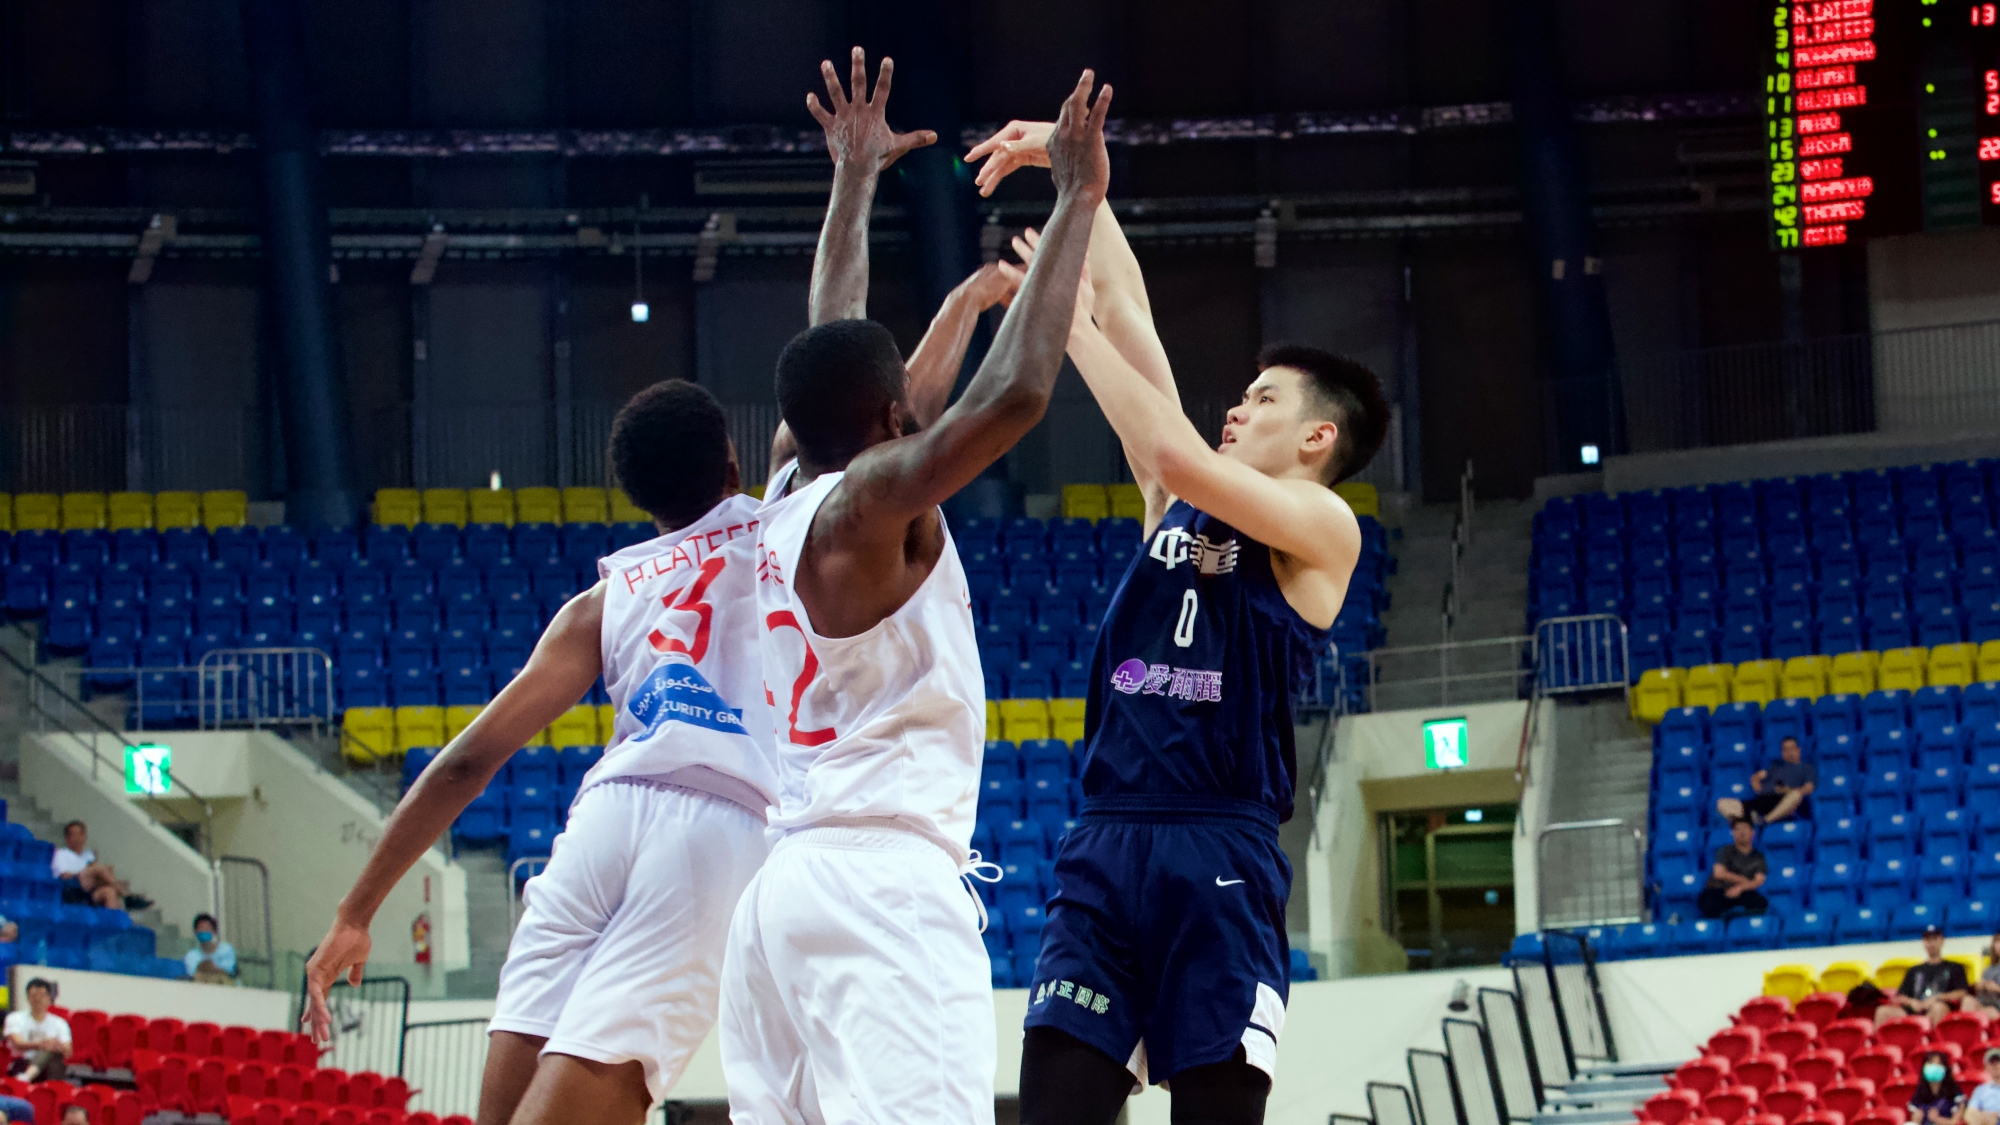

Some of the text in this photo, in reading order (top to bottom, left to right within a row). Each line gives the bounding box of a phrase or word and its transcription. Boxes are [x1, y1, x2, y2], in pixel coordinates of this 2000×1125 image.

[1774, 7, 1788, 27] 2
[1970, 3, 1997, 26] 13
[1775, 28, 1789, 49] 3
[1776, 51, 1790, 69] 4
[1767, 72, 1791, 93] 10
[1984, 69, 2000, 92] 5
[1767, 95, 1791, 115] 11
[1985, 92, 2000, 116] 2
[1769, 117, 1793, 139] 13
[1770, 139, 1794, 160] 15
[1771, 161, 1795, 183] 23
[1772, 184, 1797, 206] 24
[1775, 227, 1799, 248] 77
[624, 519, 760, 595] H.LATE
[647, 555, 727, 666] 3
[1174, 588, 1198, 648] 0
[763, 609, 838, 747] 2
[1142, 663, 1223, 702] 愛爾麗
